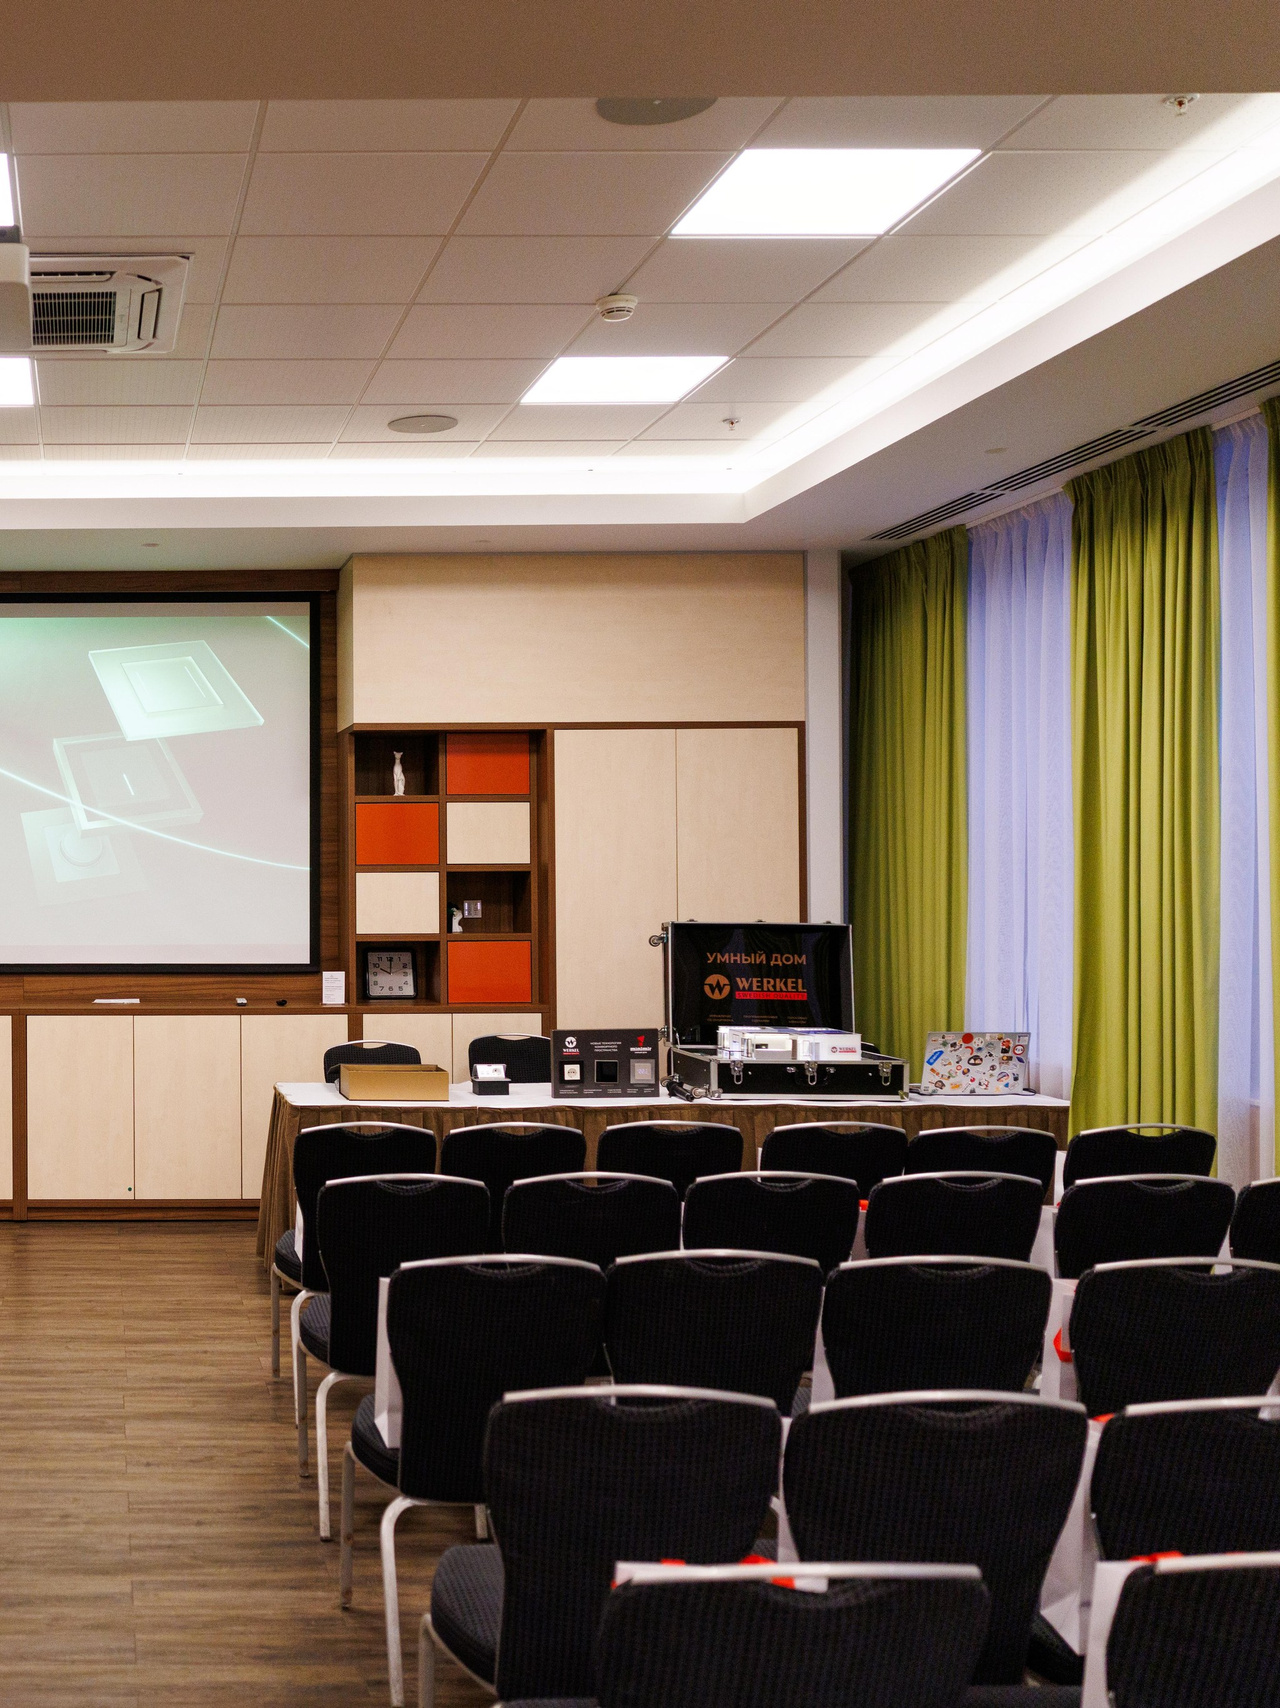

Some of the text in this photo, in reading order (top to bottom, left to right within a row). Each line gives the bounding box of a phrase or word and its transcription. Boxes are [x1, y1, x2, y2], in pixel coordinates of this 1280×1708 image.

[706, 951, 807, 966] УМНЫЙ ДОМ
[735, 977, 807, 992] WERKEL
